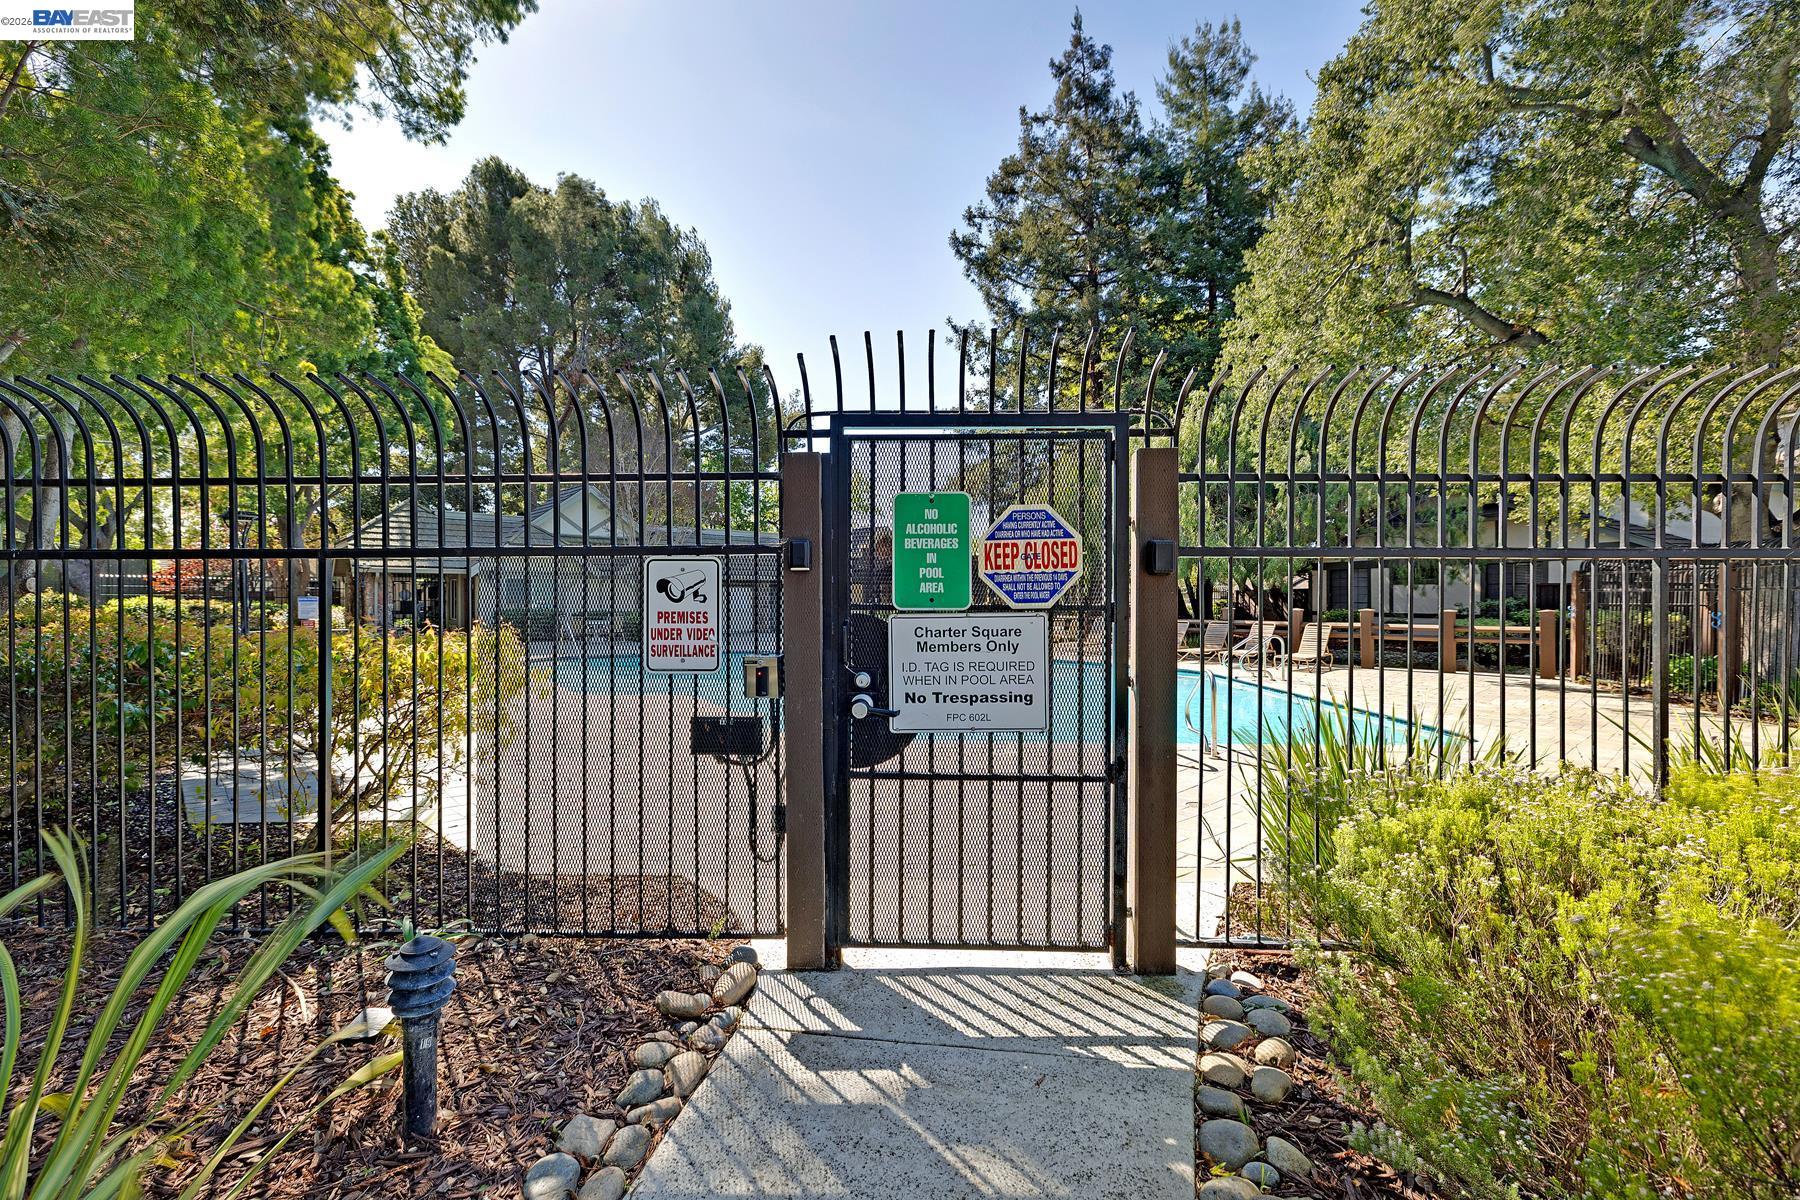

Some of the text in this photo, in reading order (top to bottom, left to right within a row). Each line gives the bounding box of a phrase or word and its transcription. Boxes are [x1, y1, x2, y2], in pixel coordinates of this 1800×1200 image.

[924, 508, 938, 520] NO
[1012, 511, 1047, 520] PERSONS
[905, 523, 958, 535] ALCOHOLIC
[1002, 520, 1056, 529] HAVING CURRENTLY ACTIVE
[1015, 530, 1021, 538] OR
[1021, 530, 1030, 538] WHO
[1031, 529, 1041, 537] HAVE
[1050, 529, 1064, 537] ACTIVE
[904, 538, 959, 549] BEVERAGES
[926, 552, 937, 564] IN
[984, 540, 1078, 571] KEEP CLOSED
[1020, 552, 1041, 561] GATE
[919, 567, 944, 578] POOL
[1026, 573, 1034, 582] THE
[919, 582, 944, 593] AREA
[1002, 582, 1061, 591] SHALL NOT BE ALLOWED TO
[1013, 591, 1024, 600] ENTER
[1031, 591, 1040, 599] POOL
[1040, 591, 1050, 599] WATER
[657, 611, 709, 624] PREMISES
[650, 627, 683, 641] UNDER
[914, 625, 1022, 640] Charter Square
[650, 644, 716, 658] SURVEILLANCE
[916, 640, 1020, 655] Members Only
[901, 660, 1036, 673] I.D. TAG IS REQUIRED
[902, 674, 1035, 686] WHEN IN POOL AREA
[904, 691, 1034, 706] No Trespassing
[946, 713, 991, 722] FPC 602L
